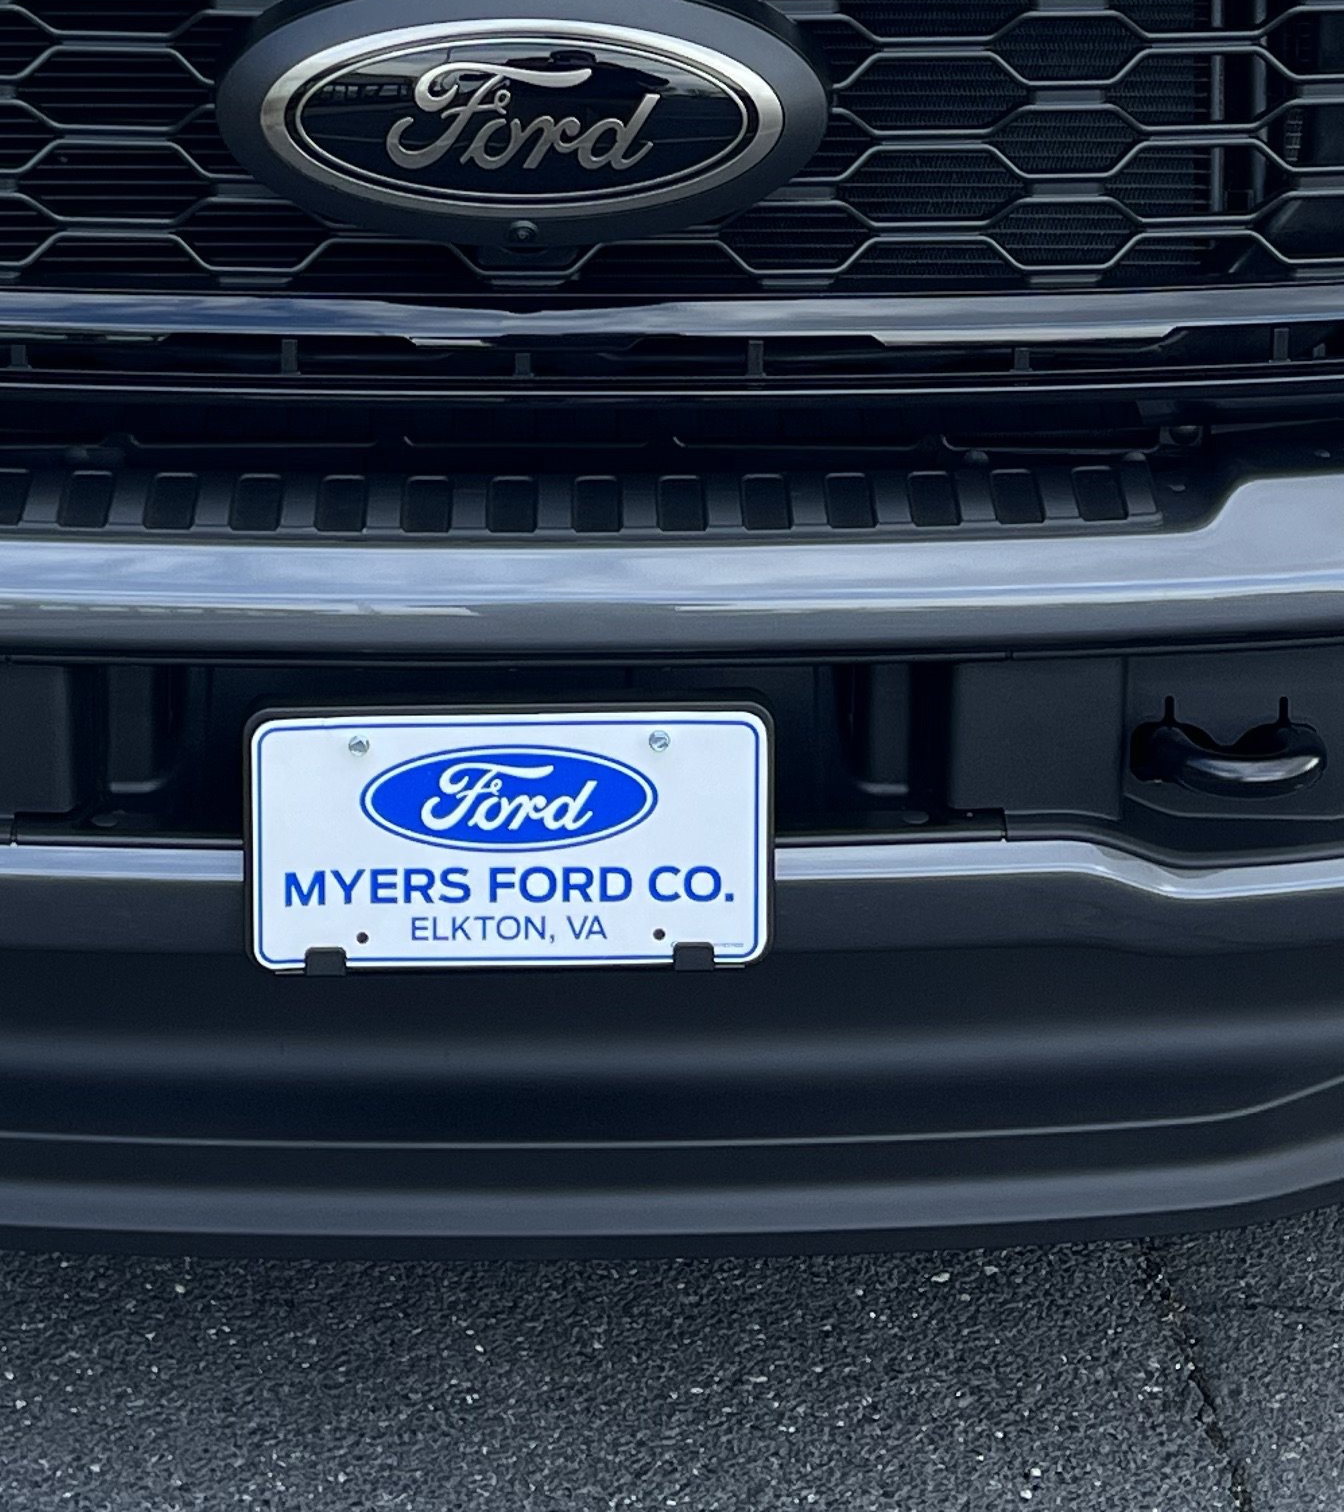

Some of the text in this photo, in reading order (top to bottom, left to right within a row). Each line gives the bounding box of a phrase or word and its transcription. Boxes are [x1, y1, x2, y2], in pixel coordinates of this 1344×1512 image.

[386, 61, 660, 171] Ford
[420, 761, 598, 832] Ford
[283, 864, 735, 908] MYERS FORD CO.
[411, 915, 608, 943] ELKTON, VA
